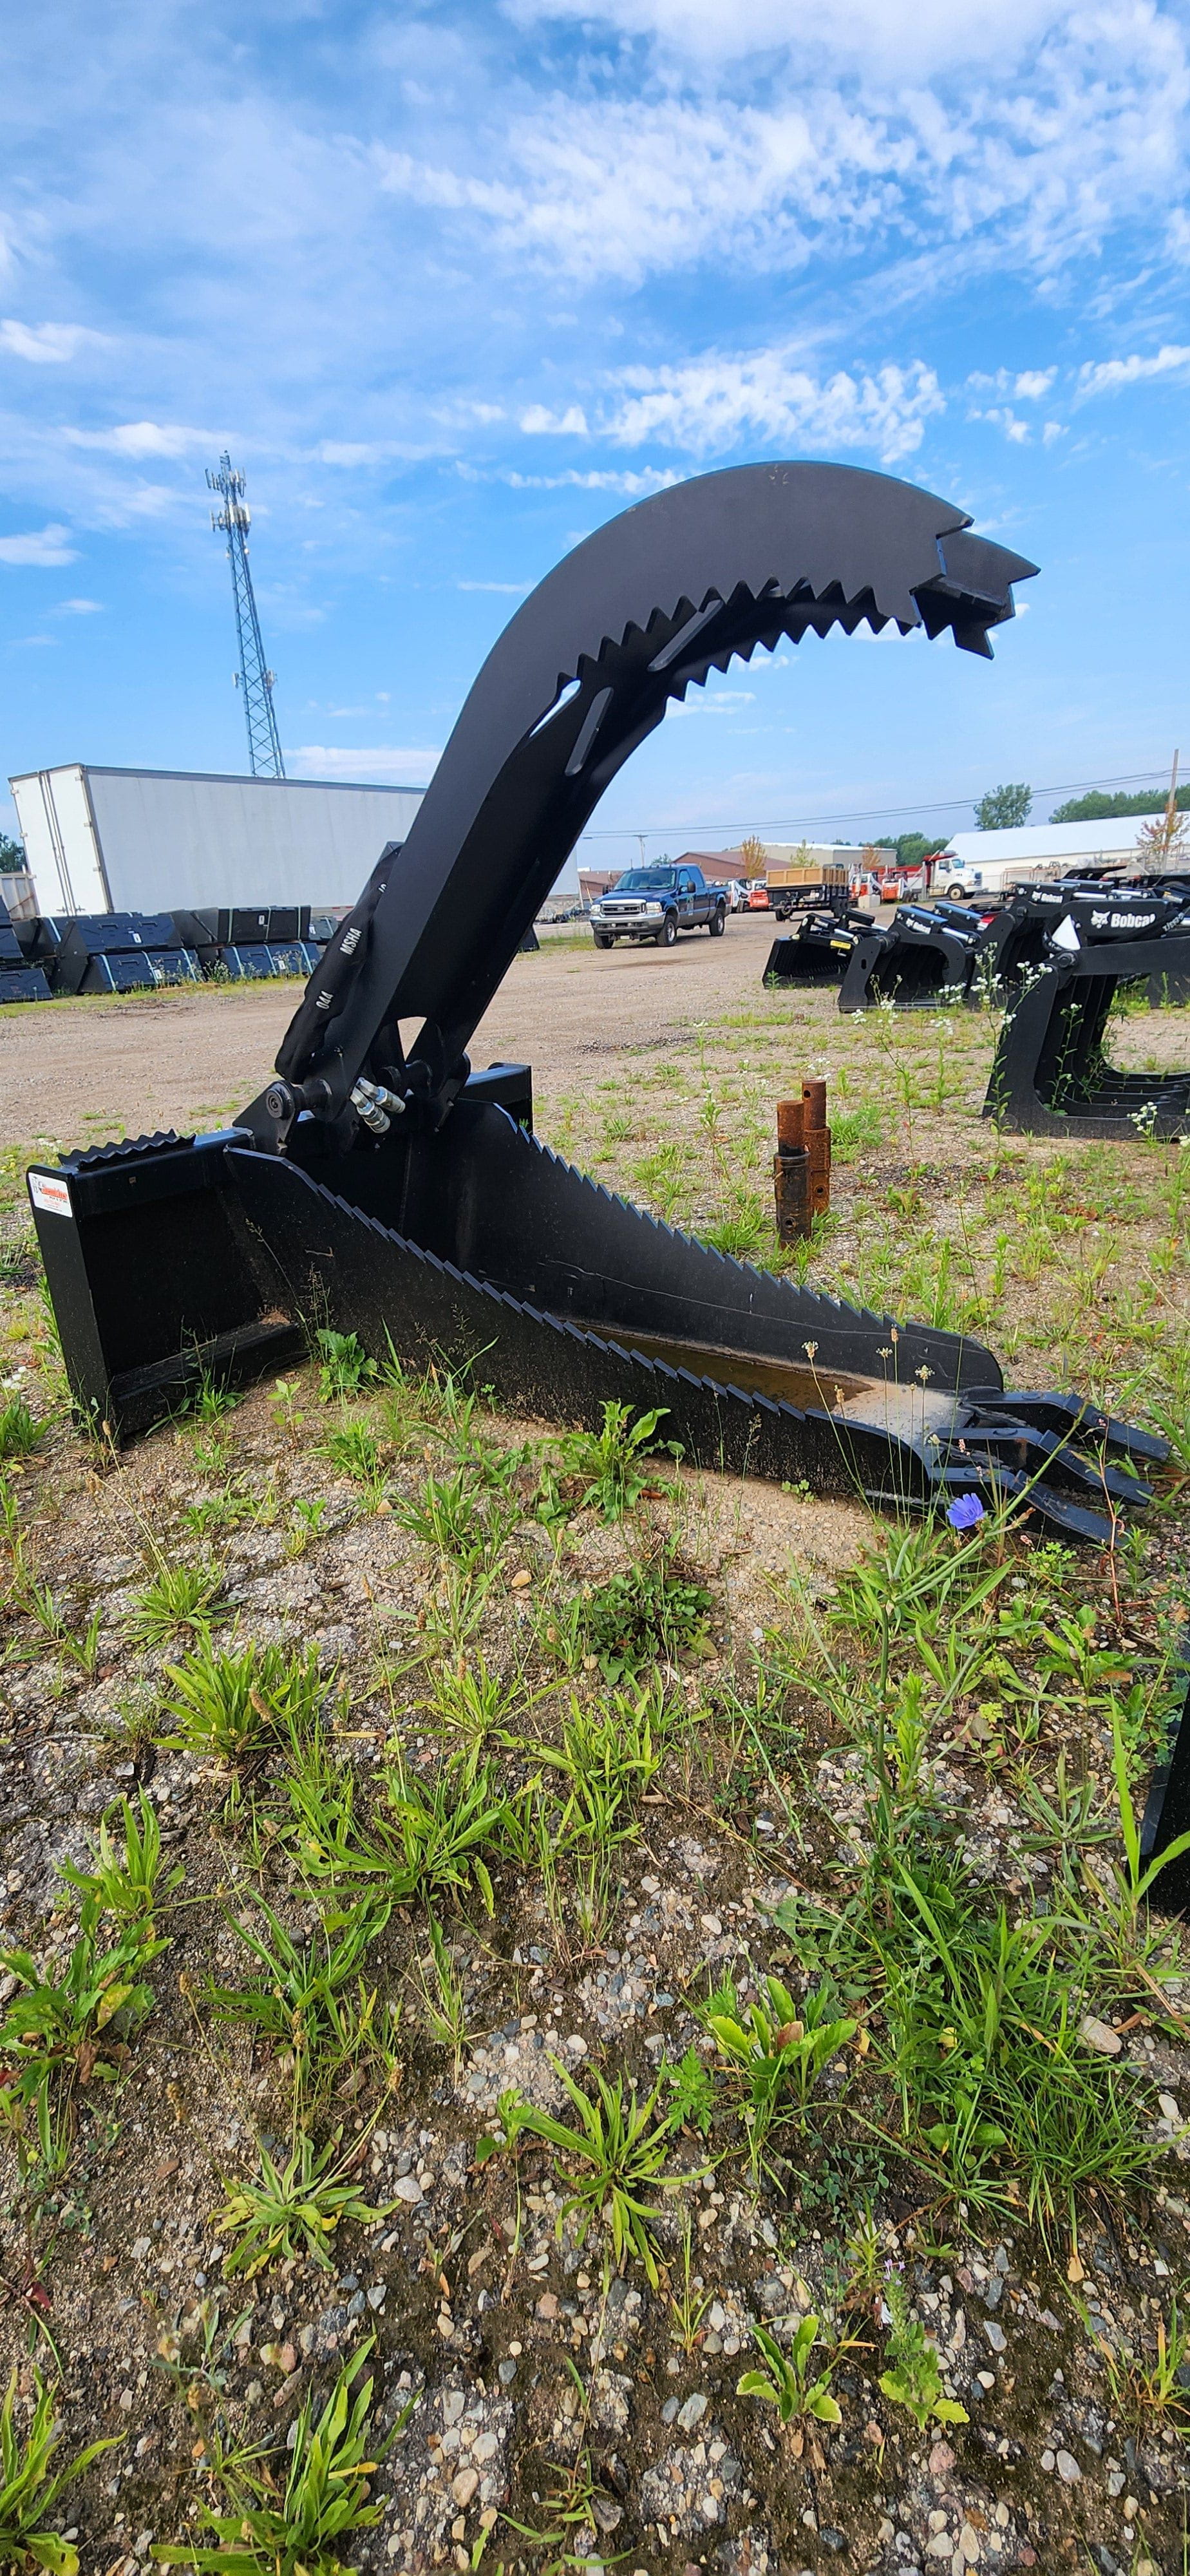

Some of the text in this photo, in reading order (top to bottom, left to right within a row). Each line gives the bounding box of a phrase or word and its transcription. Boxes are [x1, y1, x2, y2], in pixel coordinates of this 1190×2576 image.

[1111, 913, 1155, 927] Bobcat
[316, 990, 334, 1009] 044
[340, 927, 362, 954] MSHA
